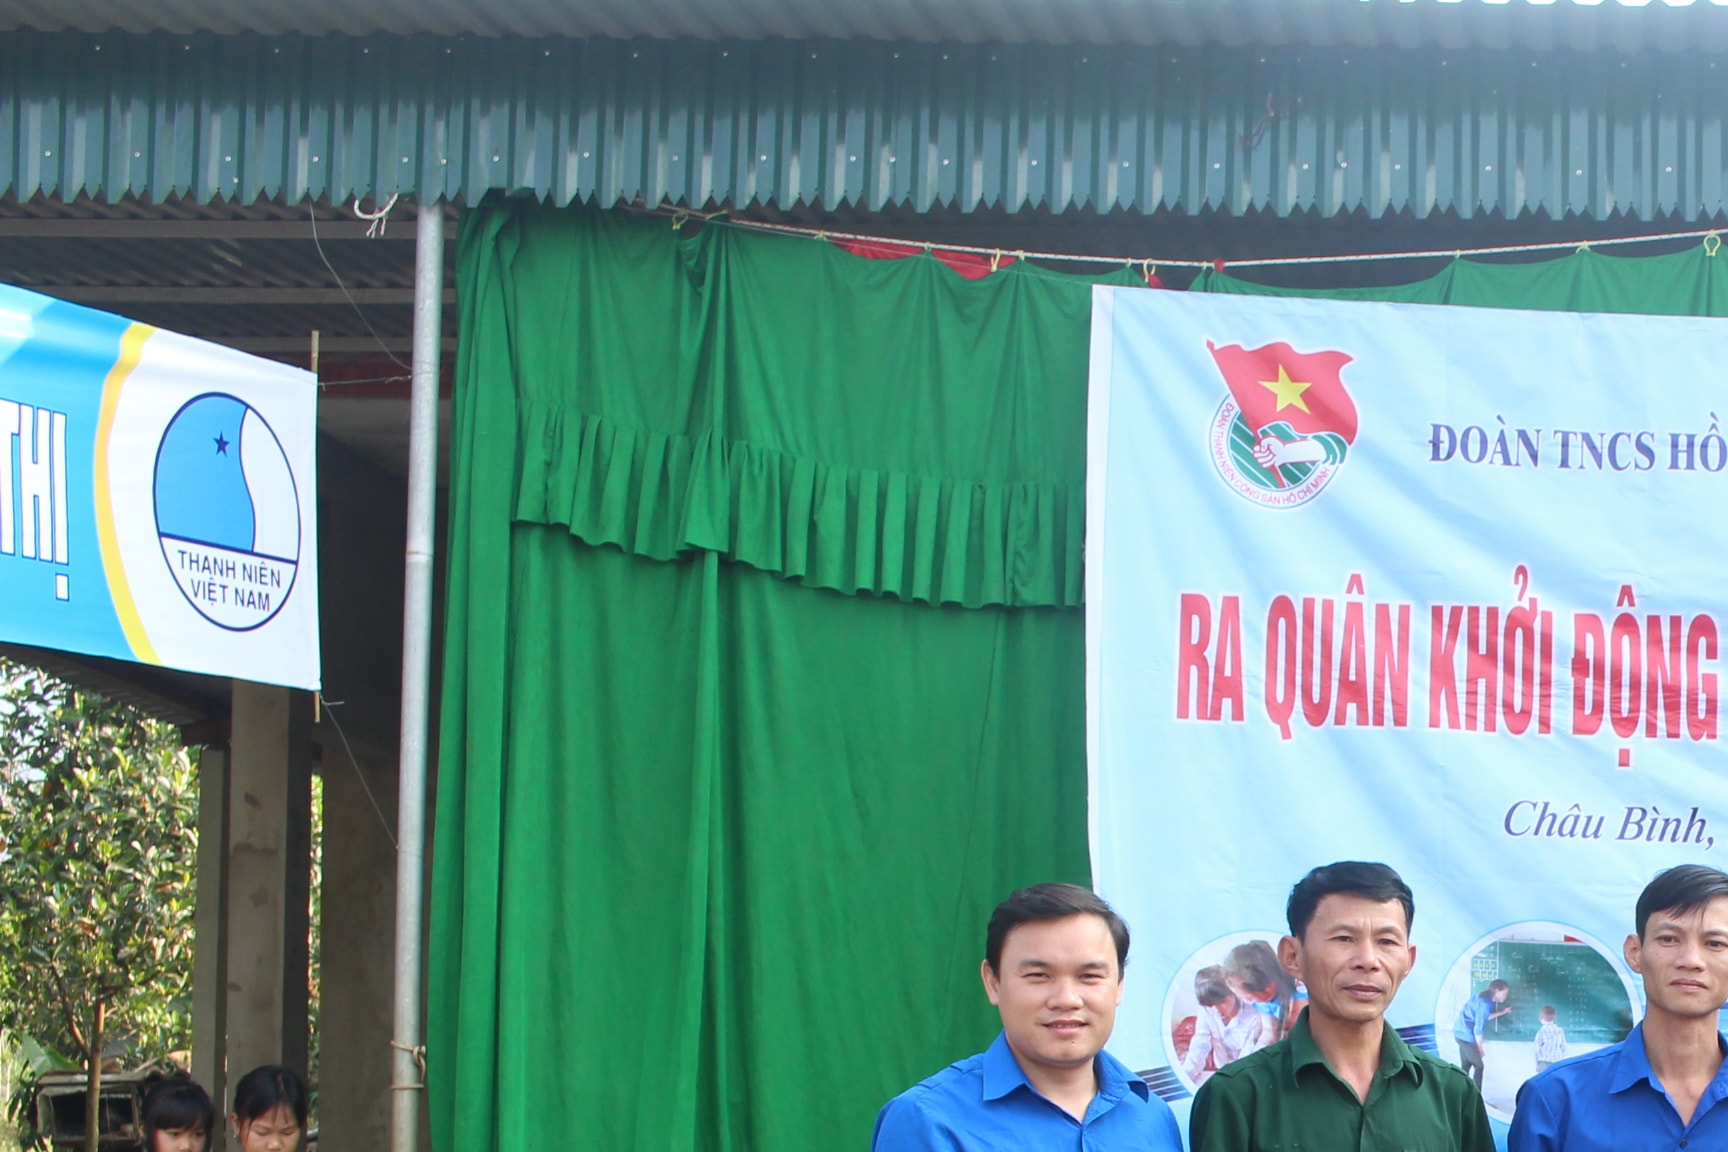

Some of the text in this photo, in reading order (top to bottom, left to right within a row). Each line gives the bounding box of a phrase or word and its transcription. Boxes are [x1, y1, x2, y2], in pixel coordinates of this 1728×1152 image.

[1428, 414, 1542, 468] ĐOÀN
[1553, 429, 1656, 471] TNCS
[1667, 411, 1728, 472] HỒ
[178, 549, 281, 588] THANH NIÊN
[191, 577, 270, 612] VIỆT NAM
[1176, 593, 1245, 721] RA
[1264, 573, 1411, 740] QUÂN
[1428, 565, 1553, 735] KHỞI
[1571, 584, 1718, 767] ĐỘNG
[1504, 800, 1605, 839] Châu
[1615, 806, 1714, 851] Bình,
